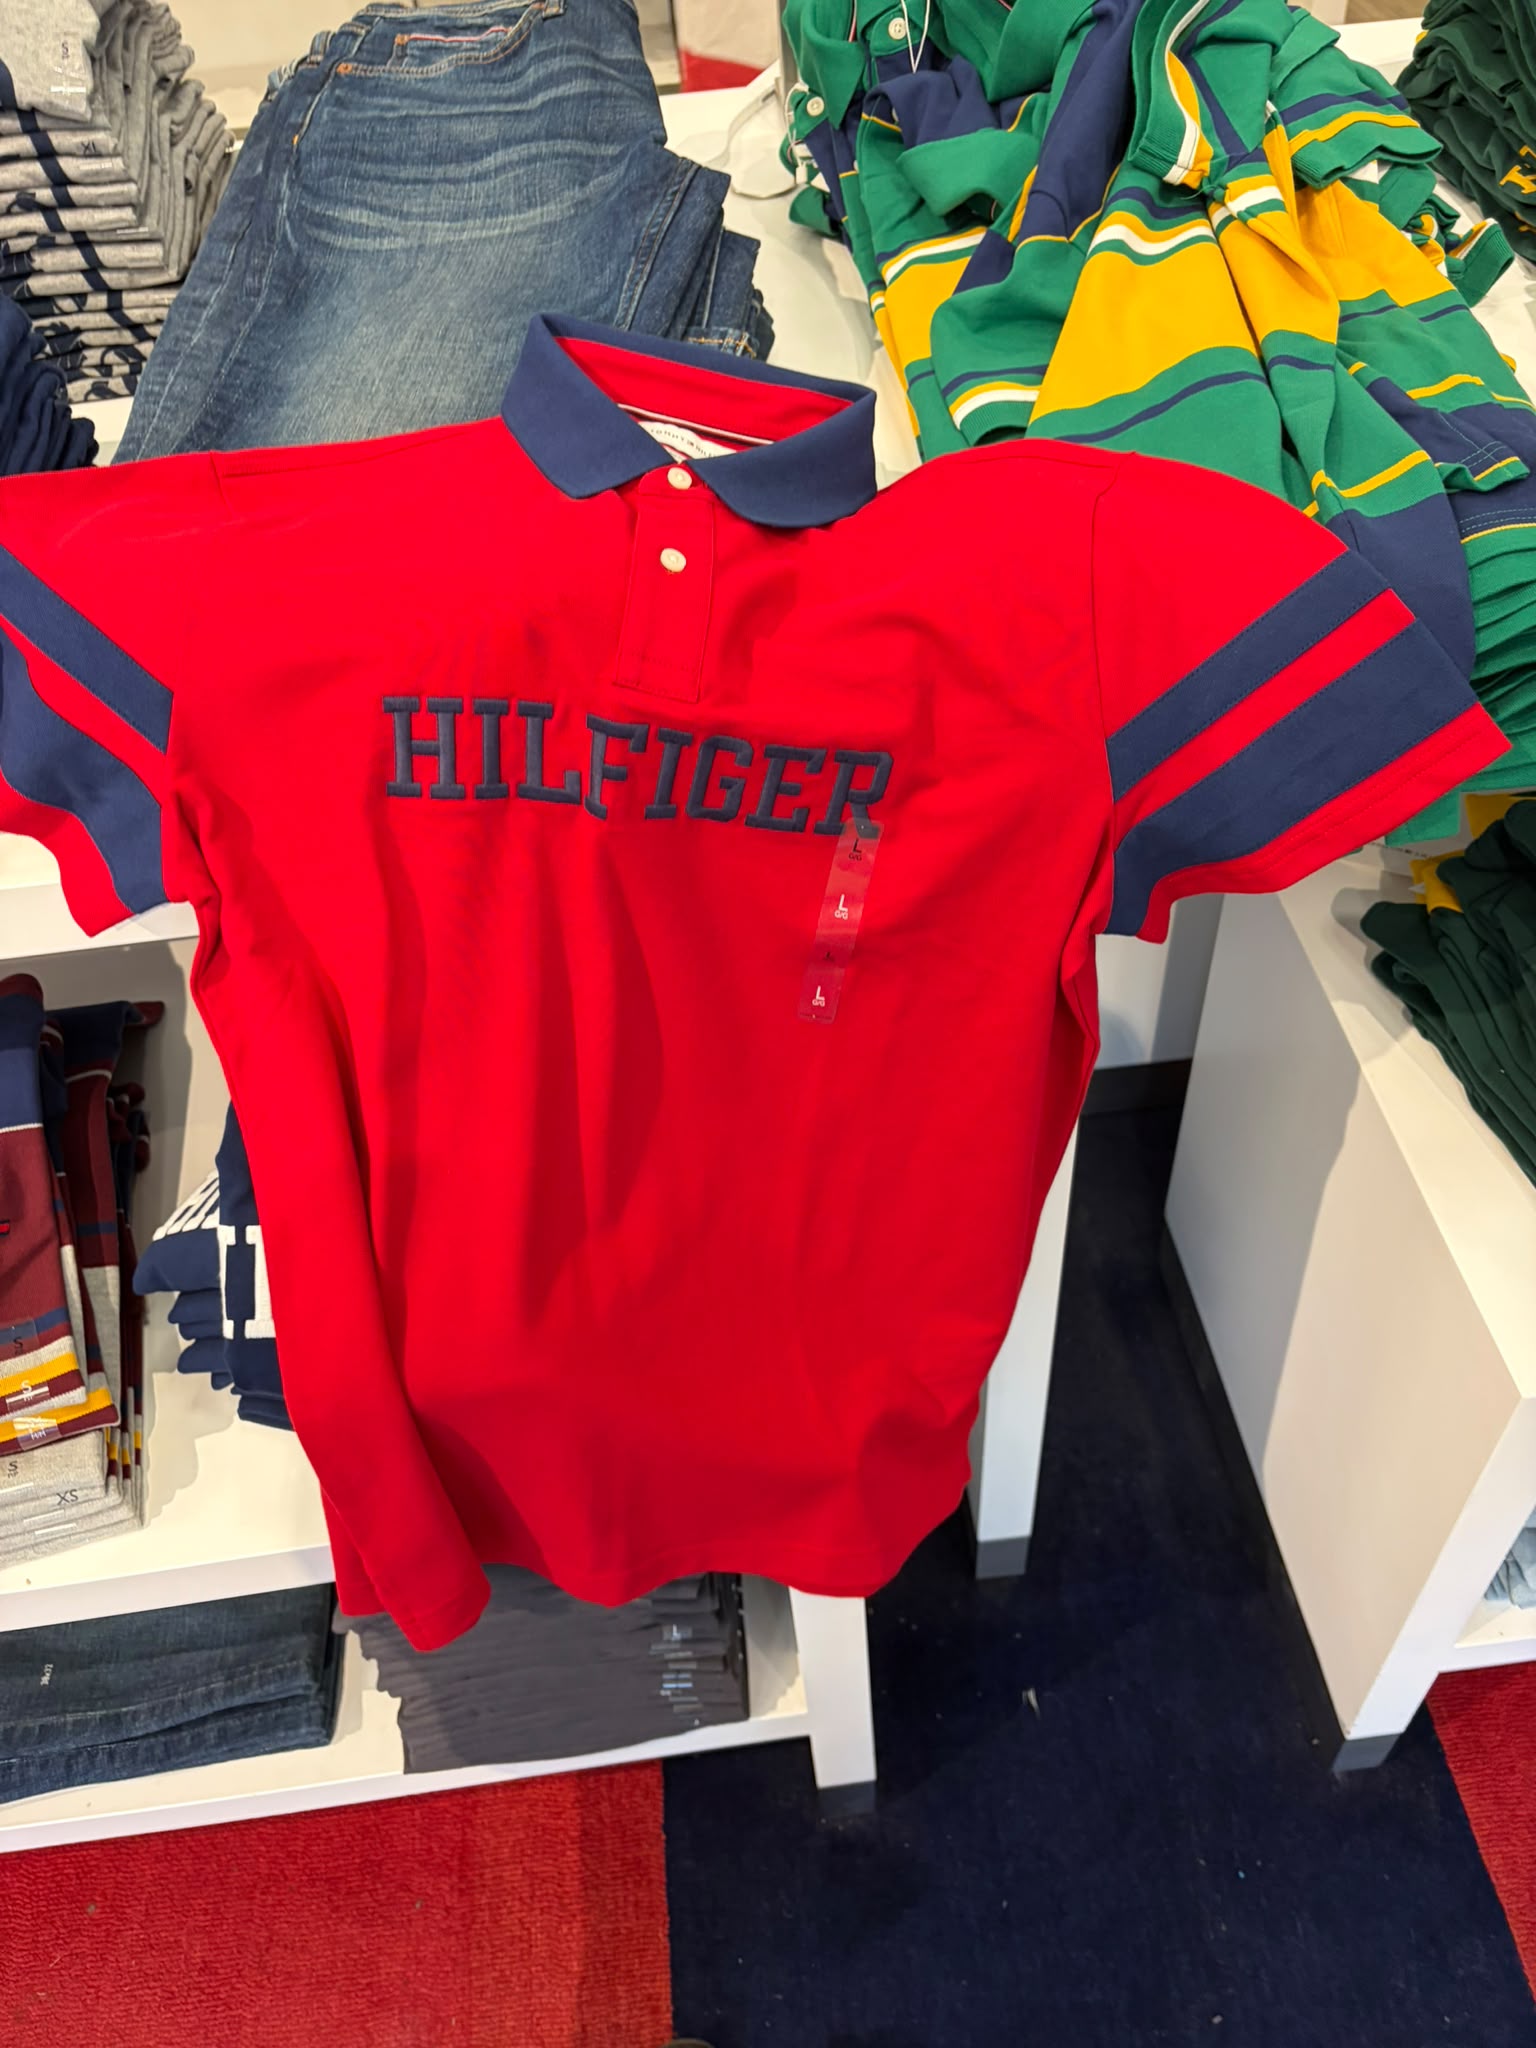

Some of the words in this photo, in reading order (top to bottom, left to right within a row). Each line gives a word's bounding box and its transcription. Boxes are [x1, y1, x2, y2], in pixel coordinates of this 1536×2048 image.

[382, 696, 894, 838] HILFIGER
[852, 838, 862, 853] L
[838, 894, 849, 912] L
[815, 985, 825, 1000] L
[13, 1336, 23, 1350] S
[8, 1461, 18, 1472] S
[56, 1489, 79, 1505] XS
